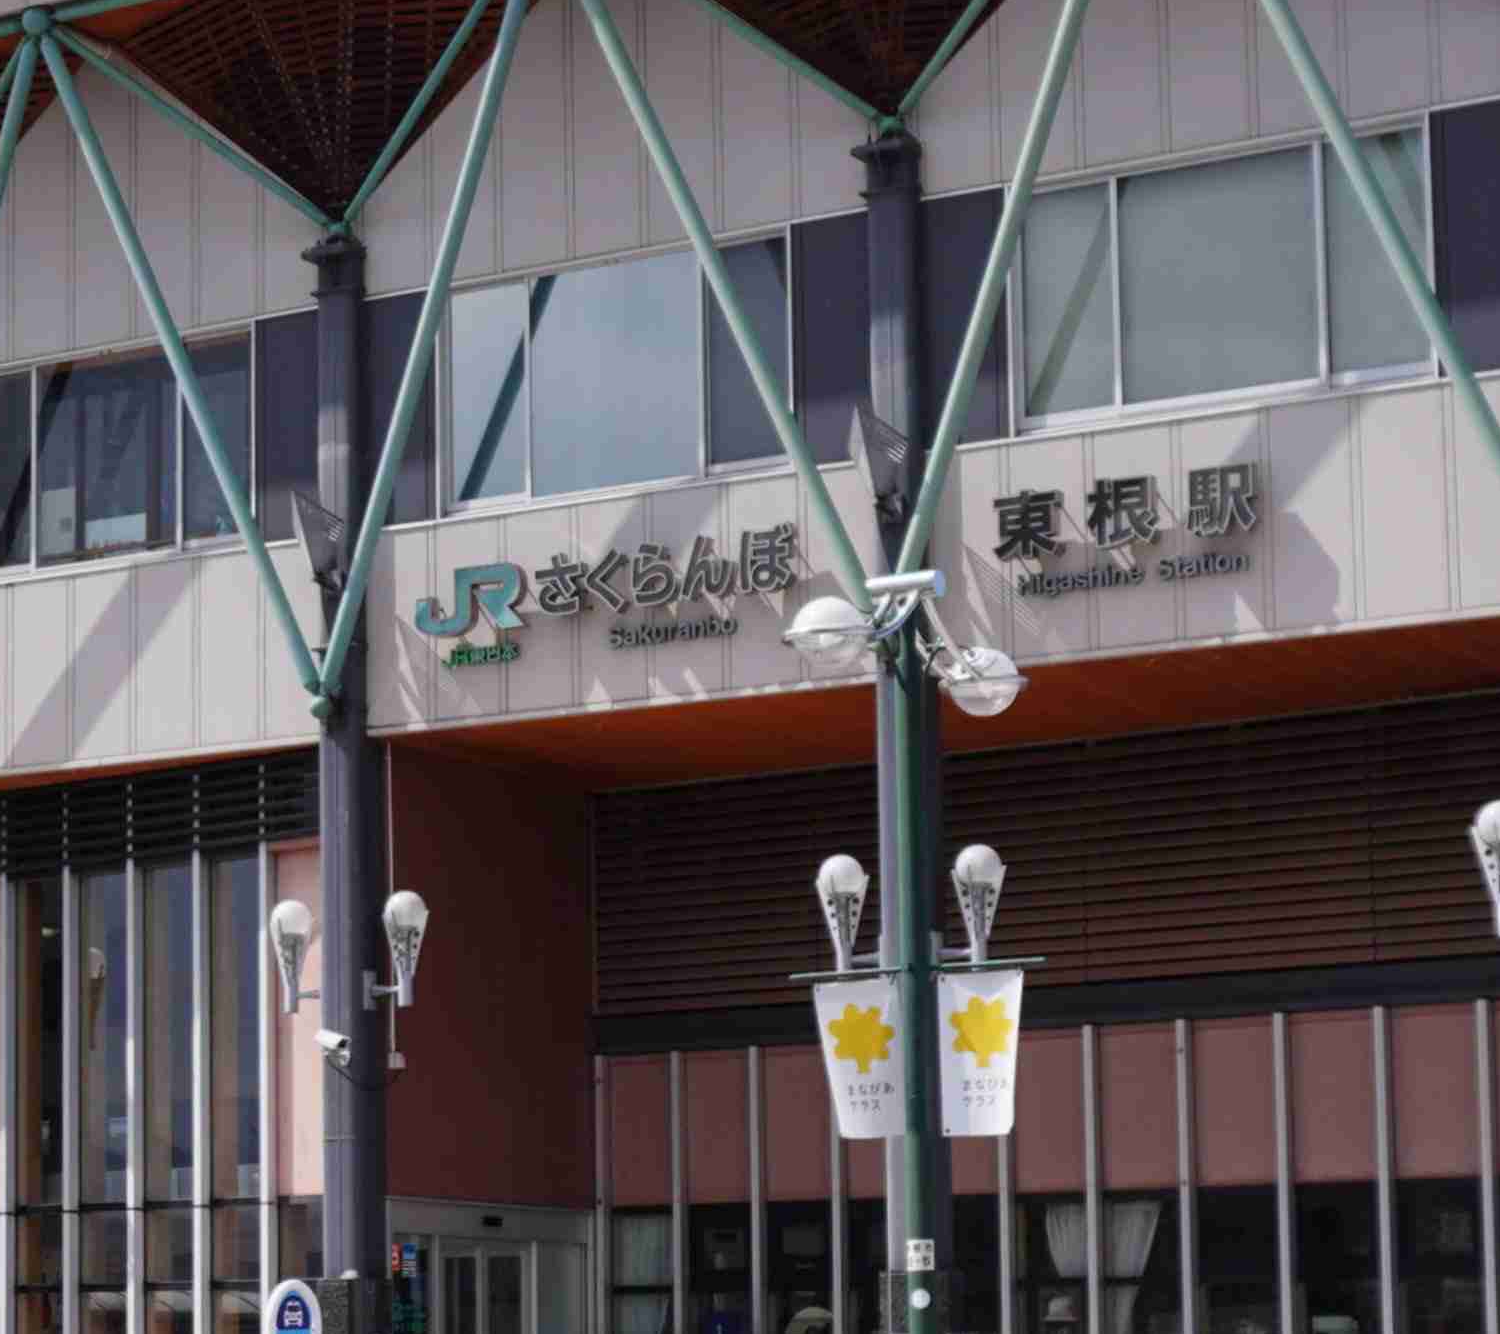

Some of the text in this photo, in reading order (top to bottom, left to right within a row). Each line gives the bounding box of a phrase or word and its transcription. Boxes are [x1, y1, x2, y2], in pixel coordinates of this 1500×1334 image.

[993, 463, 1258, 562] 東根駅
[414, 523, 799, 637] JR さくらんぼ
[1018, 554, 1250, 597] Higashine Station
[608, 616, 739, 650] Sakuranbo
